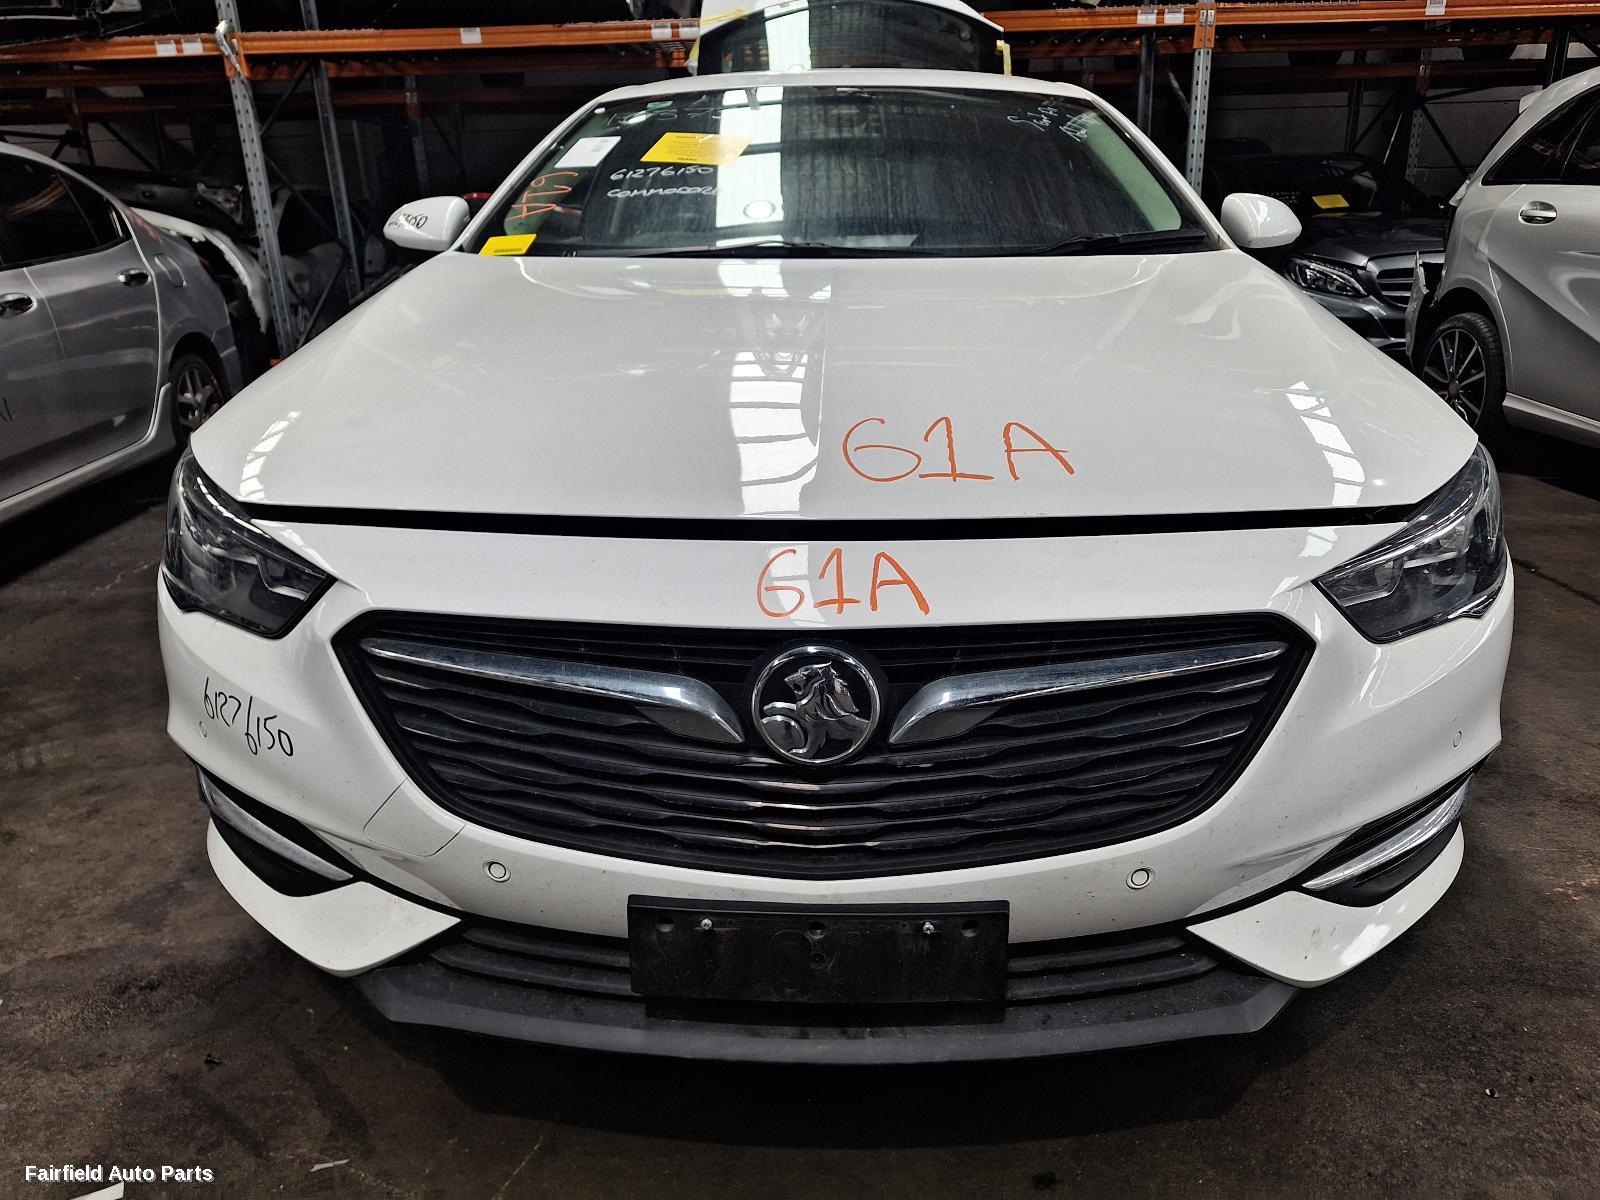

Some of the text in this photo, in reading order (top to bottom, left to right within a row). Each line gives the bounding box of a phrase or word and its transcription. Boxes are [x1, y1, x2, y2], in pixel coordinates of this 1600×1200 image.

[610, 165, 714, 180] 61276150
[842, 416, 1076, 483] 61A
[756, 547, 930, 618] 61A
